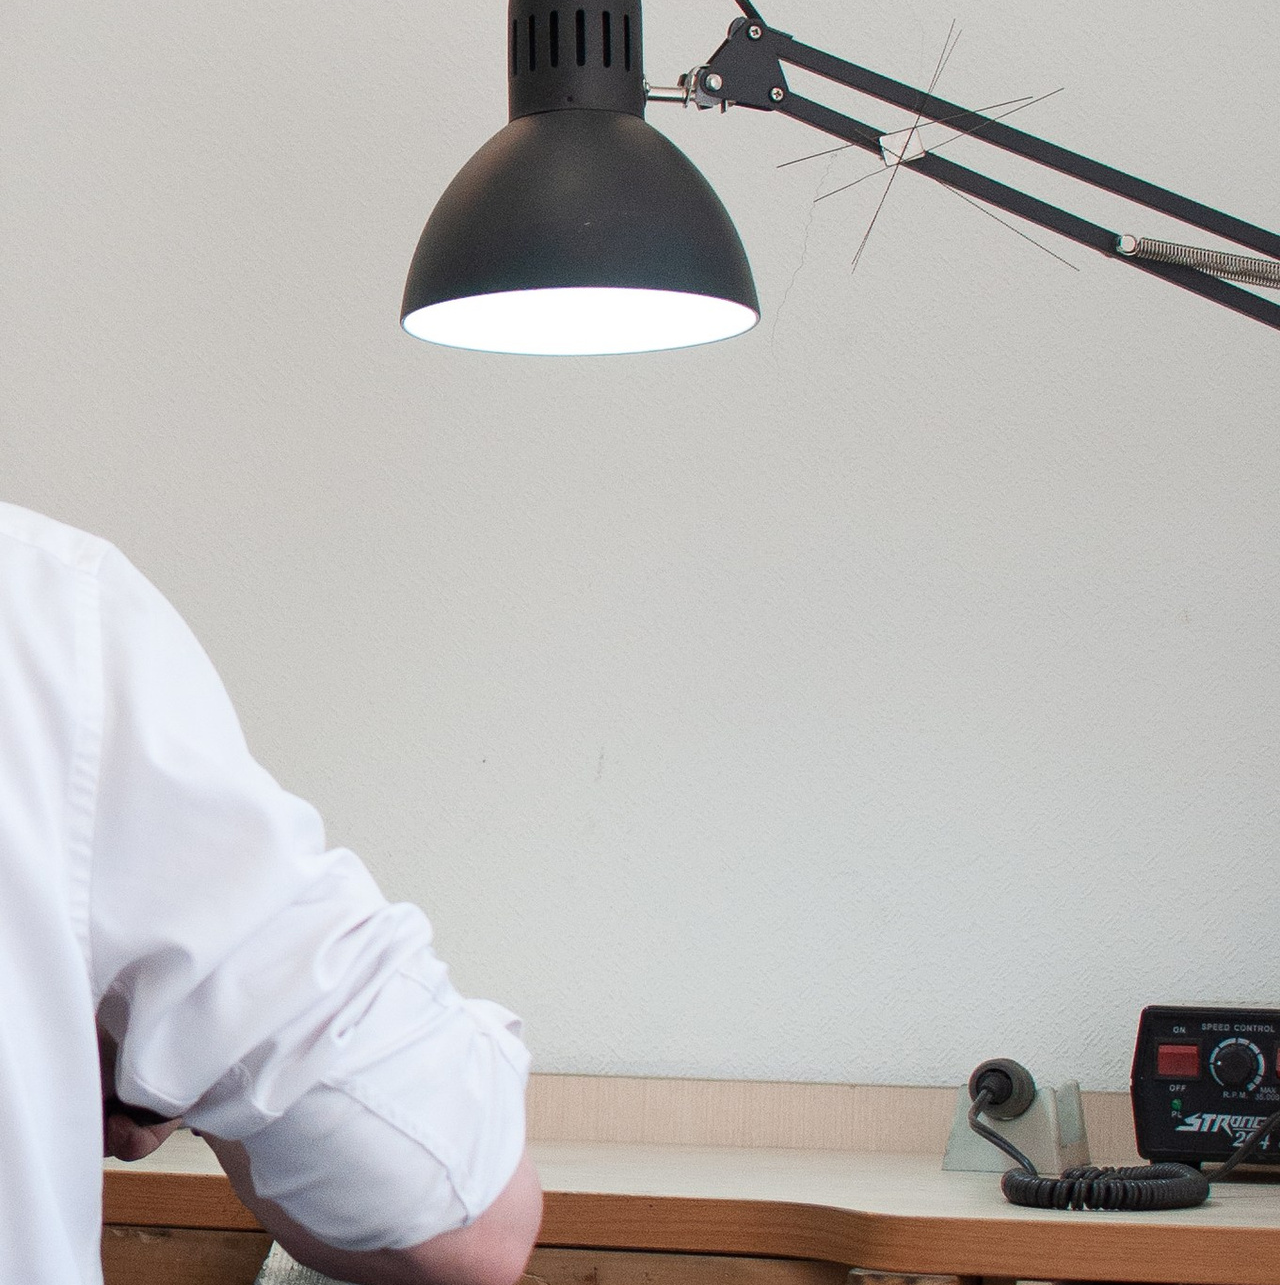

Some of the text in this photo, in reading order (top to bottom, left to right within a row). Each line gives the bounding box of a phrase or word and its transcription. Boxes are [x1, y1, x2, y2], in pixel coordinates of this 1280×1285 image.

[1172, 1026, 1186, 1034] ON
[1201, 1023, 1275, 1033] SPEED CONTROL
[1169, 1084, 1187, 1092] OFF
